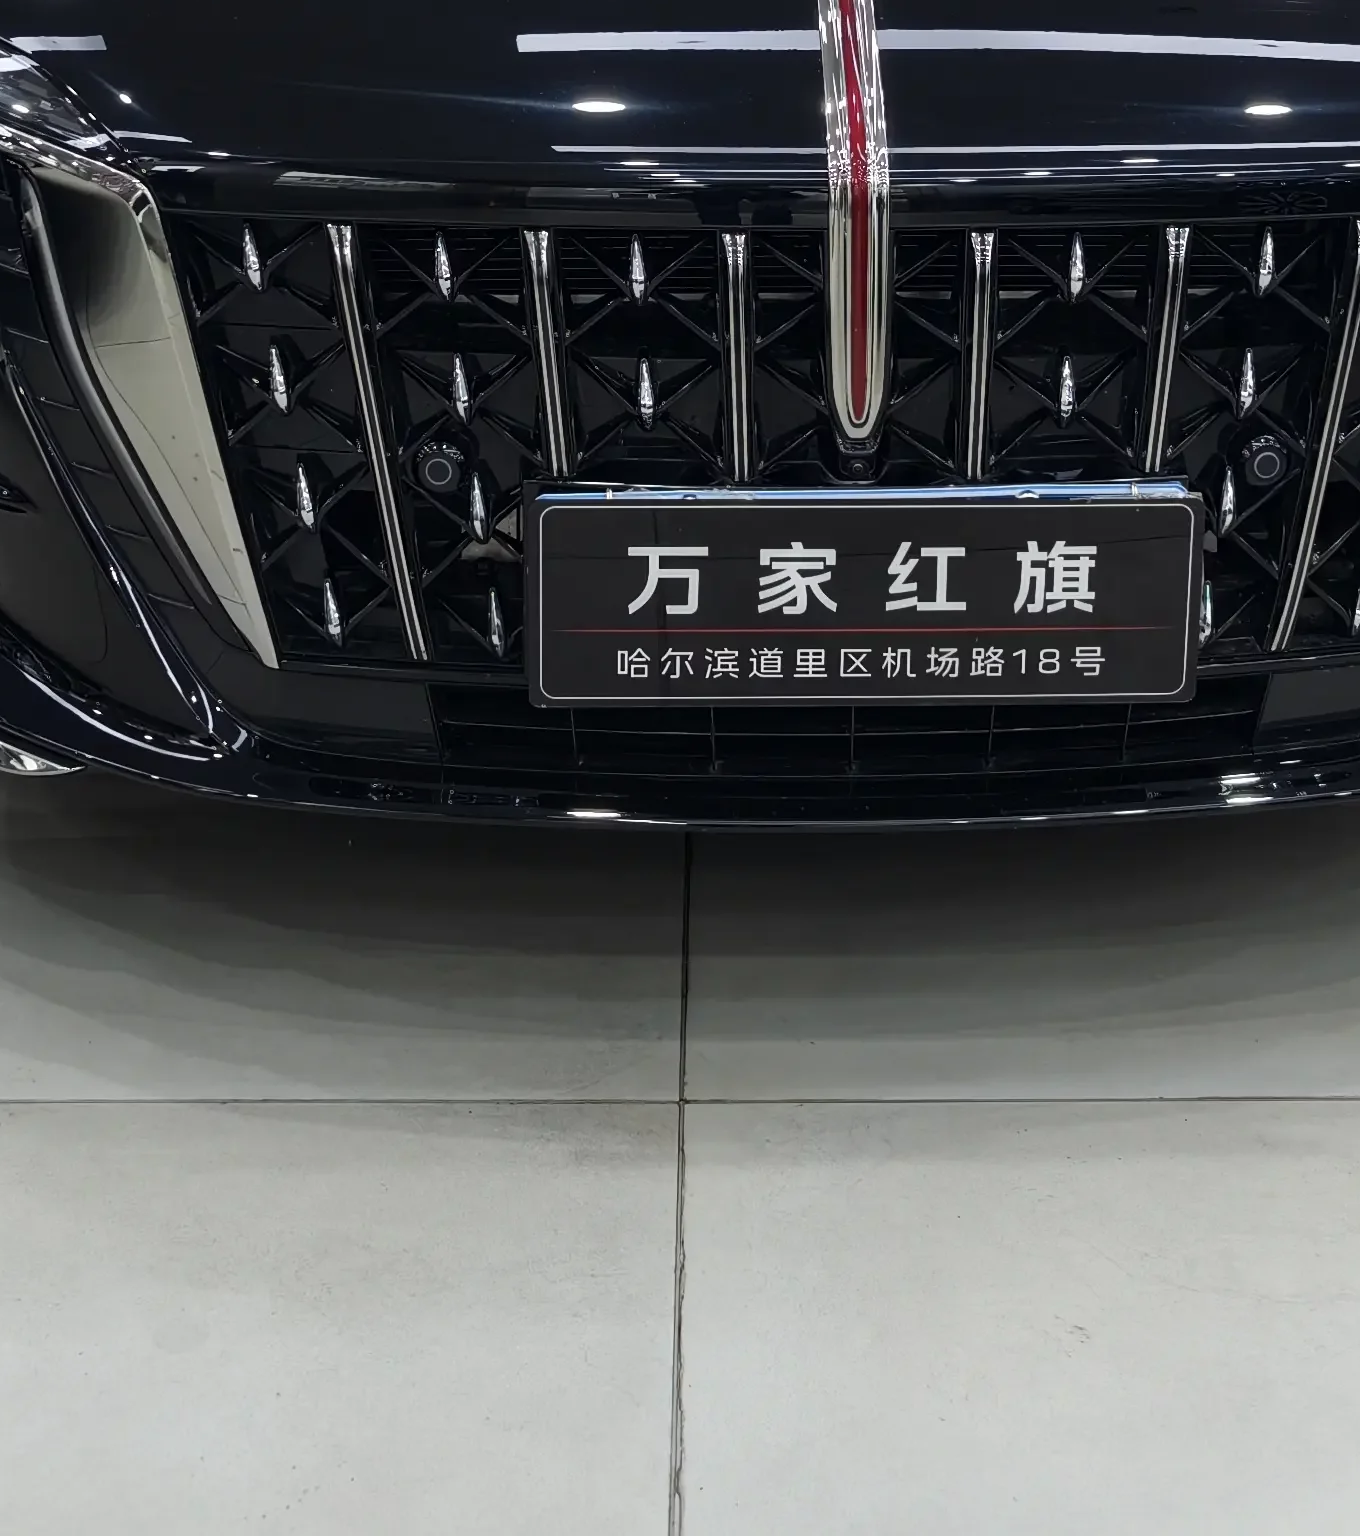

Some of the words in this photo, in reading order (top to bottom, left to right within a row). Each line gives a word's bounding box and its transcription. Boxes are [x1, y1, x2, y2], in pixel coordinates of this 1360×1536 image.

[626, 540, 1098, 616] 万家红旗
[616, 646, 1106, 679] 哈尔滨道里区机场路18号
